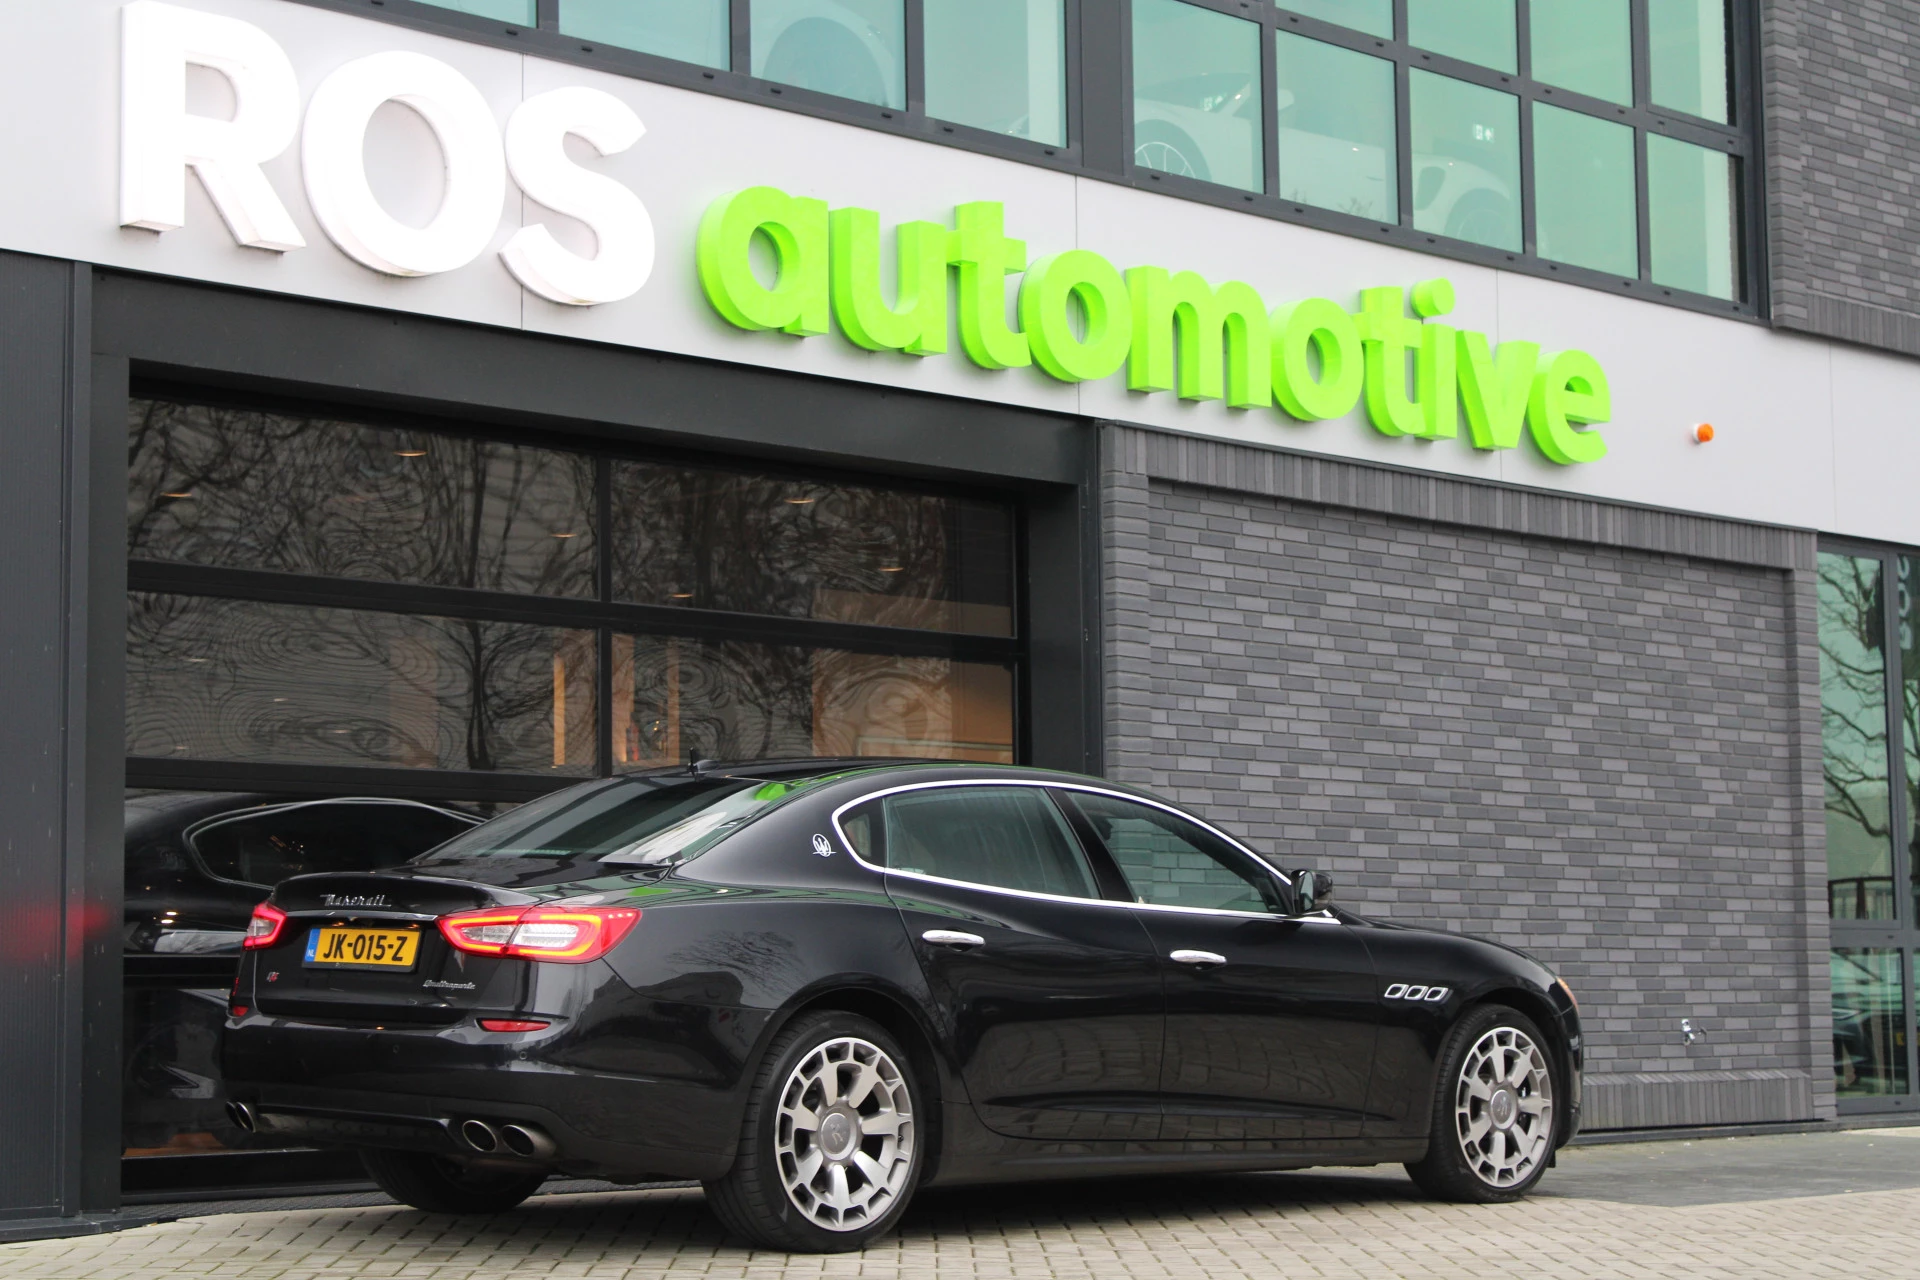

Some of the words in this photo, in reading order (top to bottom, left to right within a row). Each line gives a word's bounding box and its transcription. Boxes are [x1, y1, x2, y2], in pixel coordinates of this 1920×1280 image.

[120, 1, 656, 306] ROS
[696, 186, 1611, 466] automotive
[323, 933, 408, 962] JK-015-Z
